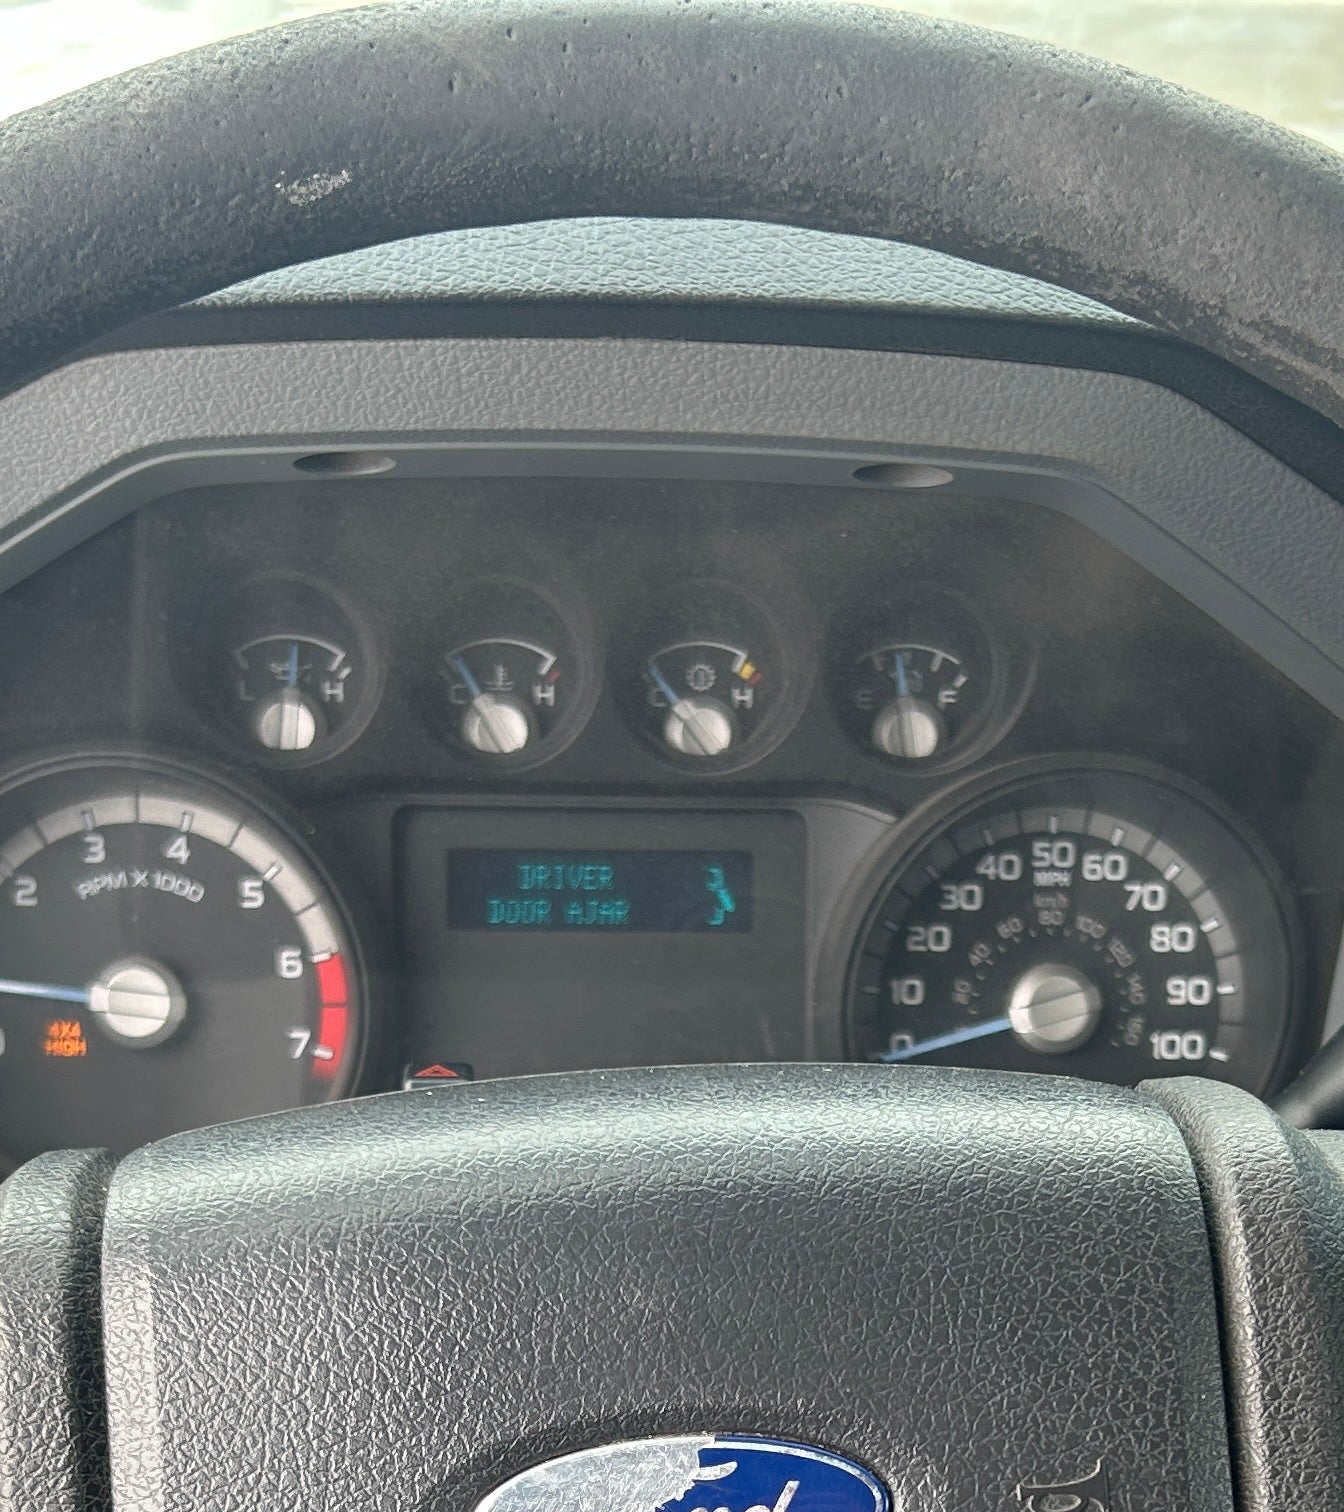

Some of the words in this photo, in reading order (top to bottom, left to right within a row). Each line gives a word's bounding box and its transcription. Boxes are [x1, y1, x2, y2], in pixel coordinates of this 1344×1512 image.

[321, 680, 344, 702] H
[531, 682, 555, 707] H
[730, 686, 754, 709] H
[83, 836, 106, 864] 3
[165, 836, 191, 865] 4
[1031, 841, 1076, 869] 50
[518, 864, 615, 890] DRIVER
[975, 853, 1022, 881] 40
[1082, 853, 1128, 882] 60
[14, 875, 38, 907] 2
[77, 870, 128, 900] RPM
[154, 869, 206, 903] 1000
[241, 878, 265, 910] 5
[940, 884, 984, 912] 30
[1124, 884, 1167, 912] 70
[487, 899, 552, 924] DOOR
[566, 899, 630, 924] AJAR
[906, 926, 953, 953] 20
[1150, 924, 1197, 954] 80
[279, 950, 304, 979] 6
[889, 978, 924, 1006] 10
[1166, 978, 1212, 1007] 90
[289, 1030, 311, 1059] 7
[1150, 1033, 1206, 1060] 100
